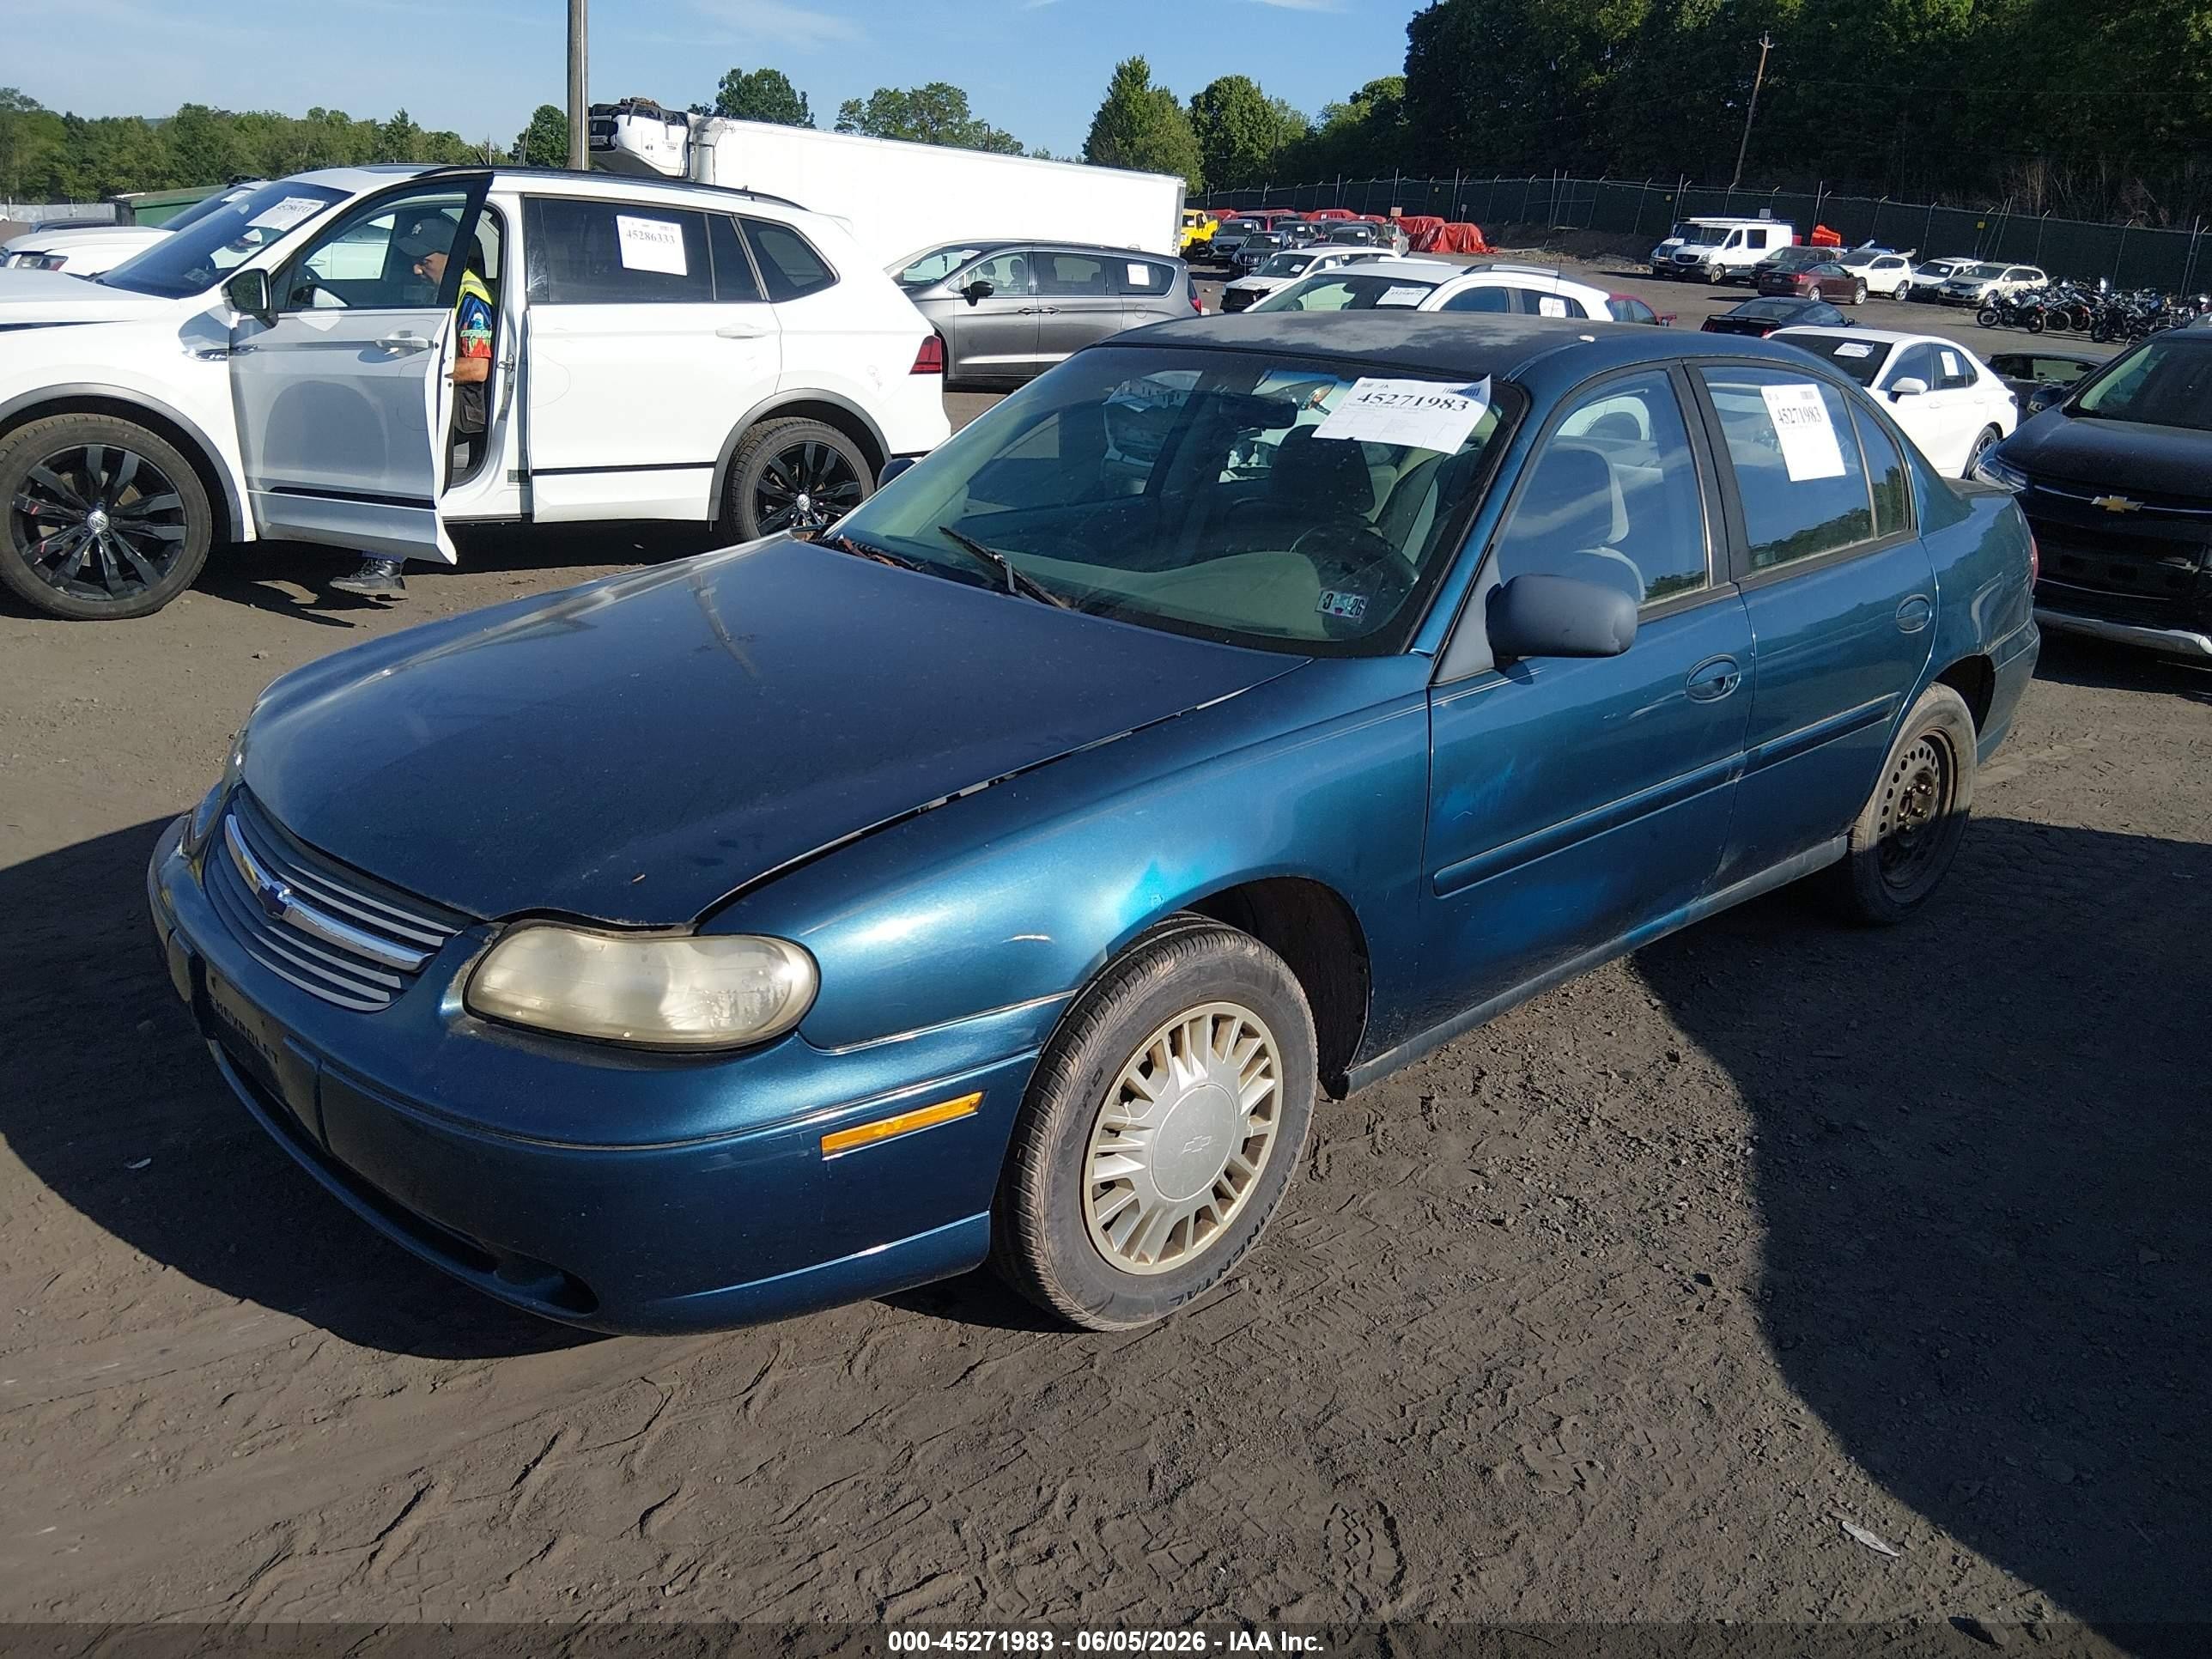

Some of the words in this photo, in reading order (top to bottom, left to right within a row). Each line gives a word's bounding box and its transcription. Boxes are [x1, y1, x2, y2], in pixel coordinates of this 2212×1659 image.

[627, 229, 675, 245] 45286333
[1357, 392, 1469, 411] 45271983
[1777, 405, 1822, 424] 45271983
[1322, 592, 1334, 610] 3
[1348, 598, 1365, 617] 26
